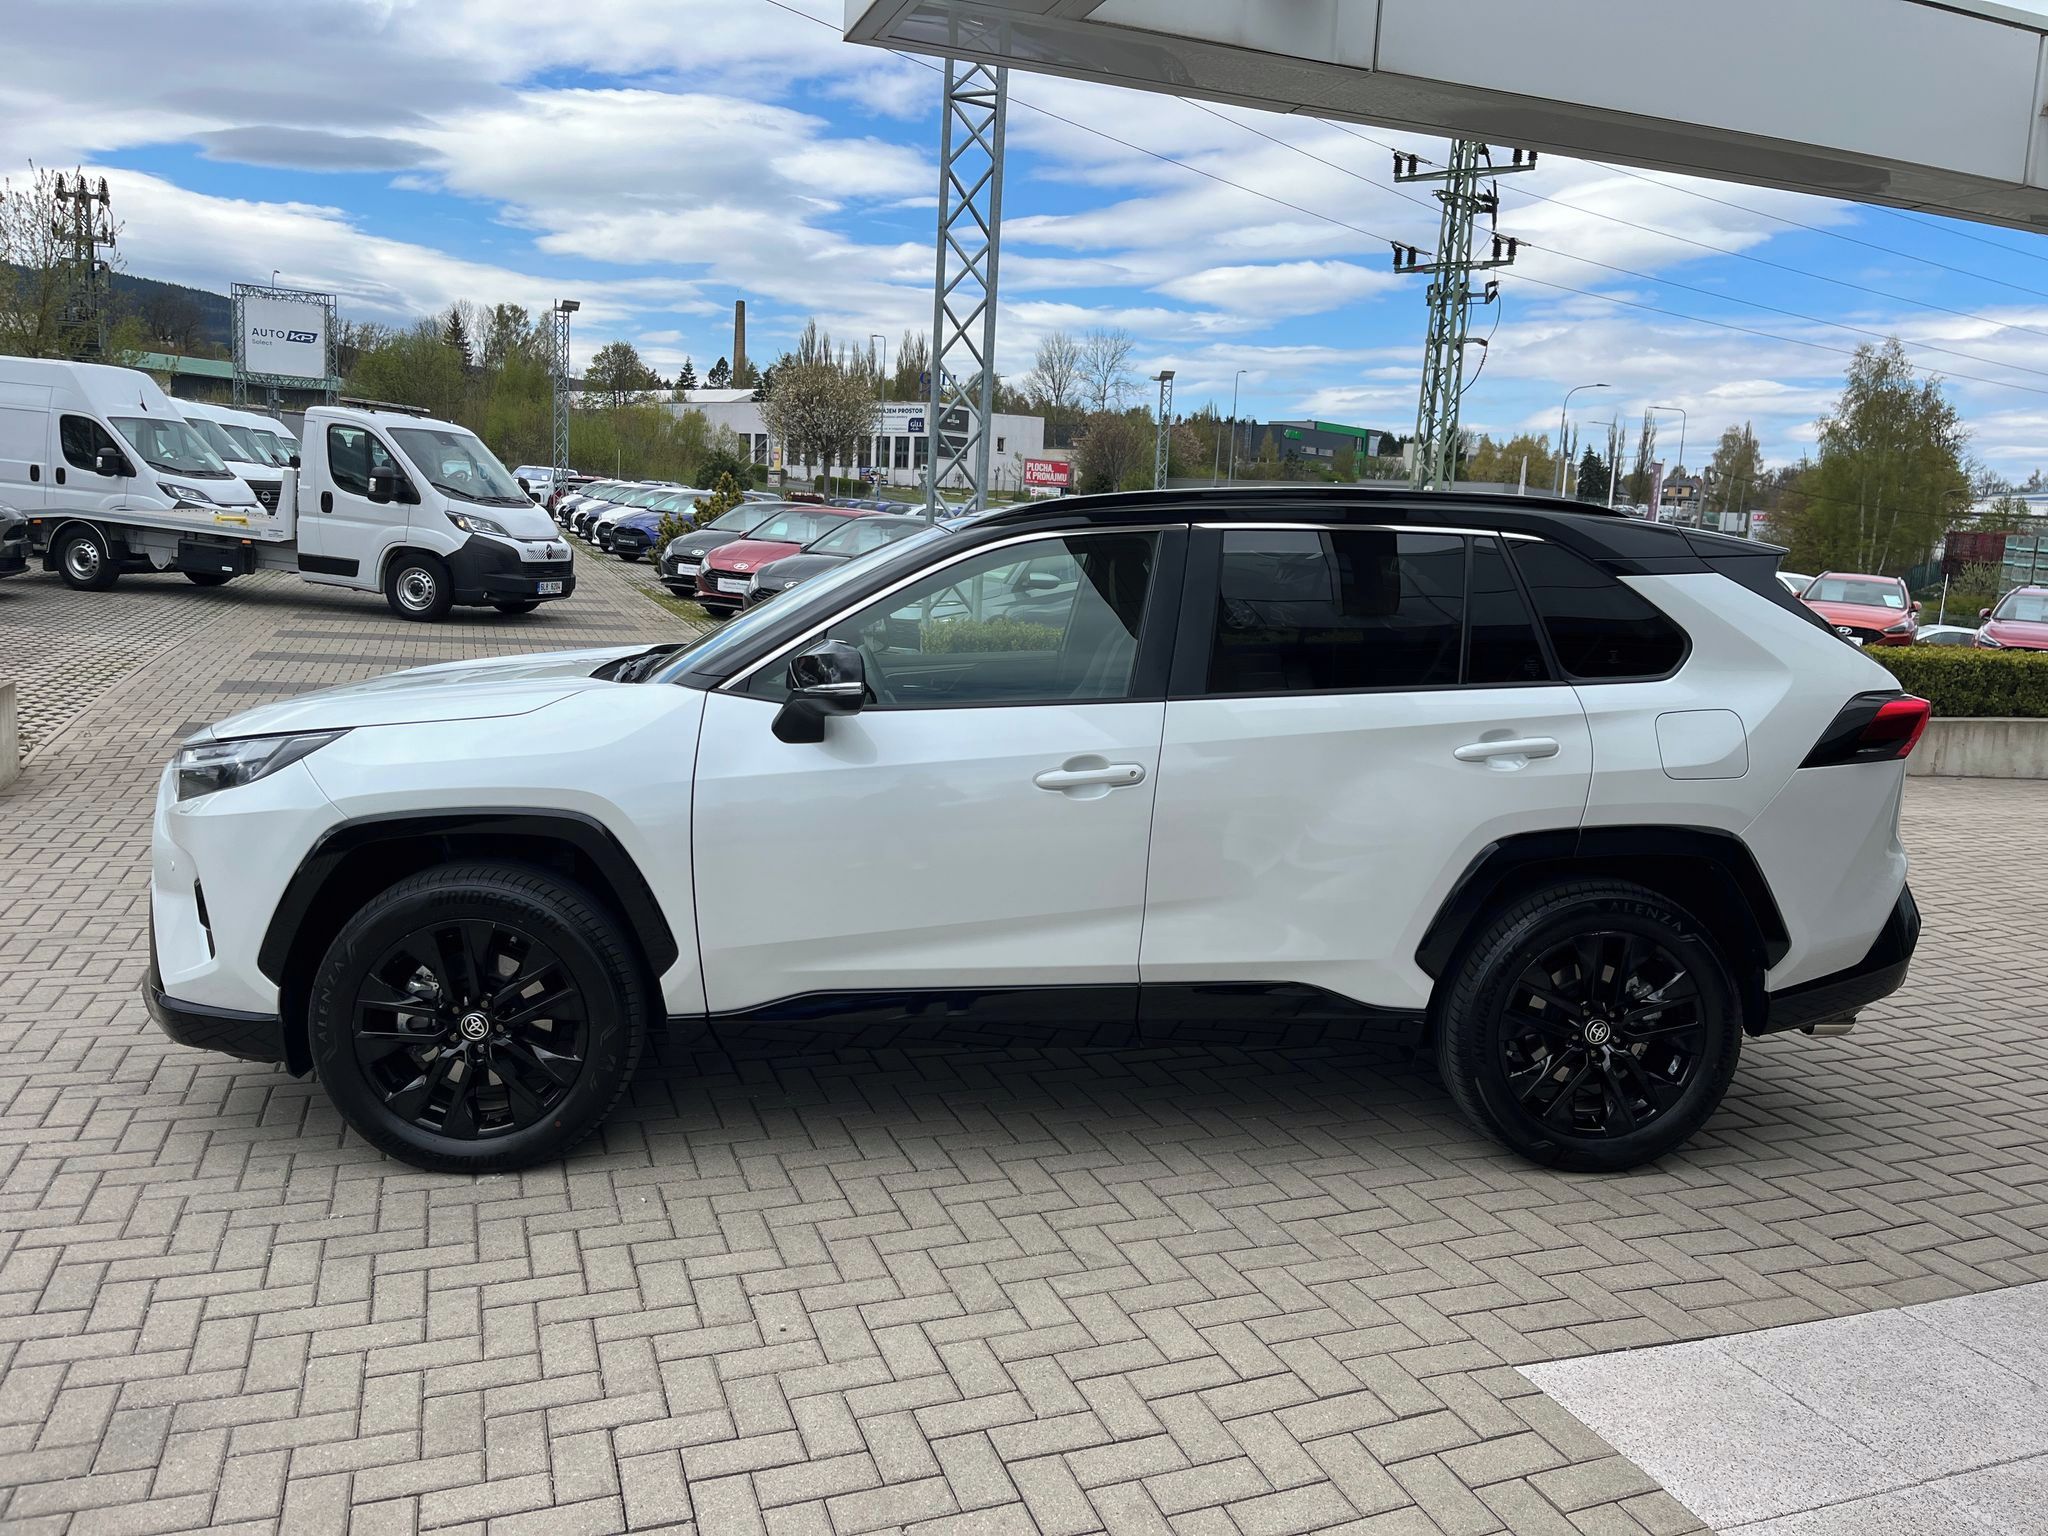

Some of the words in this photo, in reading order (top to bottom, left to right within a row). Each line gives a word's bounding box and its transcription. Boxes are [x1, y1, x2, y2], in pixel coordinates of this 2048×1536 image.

[252, 328, 285, 339] AUTO
[1026, 462, 1053, 472] PLOCHA
[1026, 471, 1031, 480] K
[430, 890, 569, 937] BRIDGESTONE
[1609, 900, 1682, 932] ALENZA
[316, 961, 346, 1044] ALENZA
